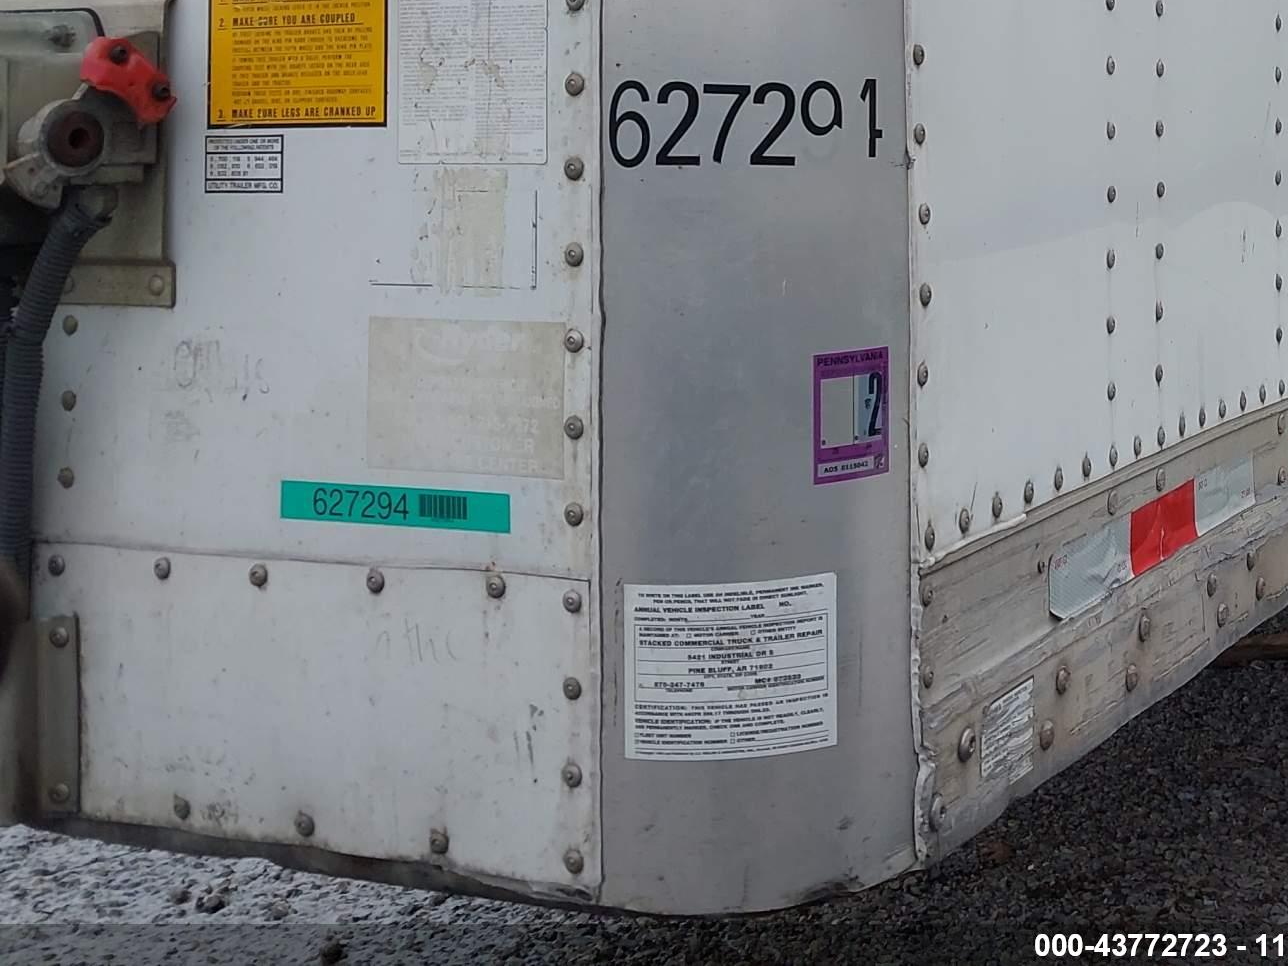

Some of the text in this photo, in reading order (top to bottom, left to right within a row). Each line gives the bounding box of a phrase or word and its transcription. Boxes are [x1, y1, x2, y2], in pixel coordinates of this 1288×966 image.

[232, 17, 254, 26] MAKE
[282, 15, 297, 25] YOU
[301, 14, 316, 24] ARE
[320, 13, 356, 24] COUPLED
[232, 108, 253, 118] MAKE
[281, 107, 300, 118] LEGS
[304, 107, 320, 117] ARE
[324, 106, 361, 116] CRANKED
[365, 106, 376, 116] UP
[816, 351, 883, 366] PENNSYLVANIA
[313, 488, 409, 520] 627294
[763, 634, 795, 642] TRAILER
[797, 630, 823, 638] REPAIR
